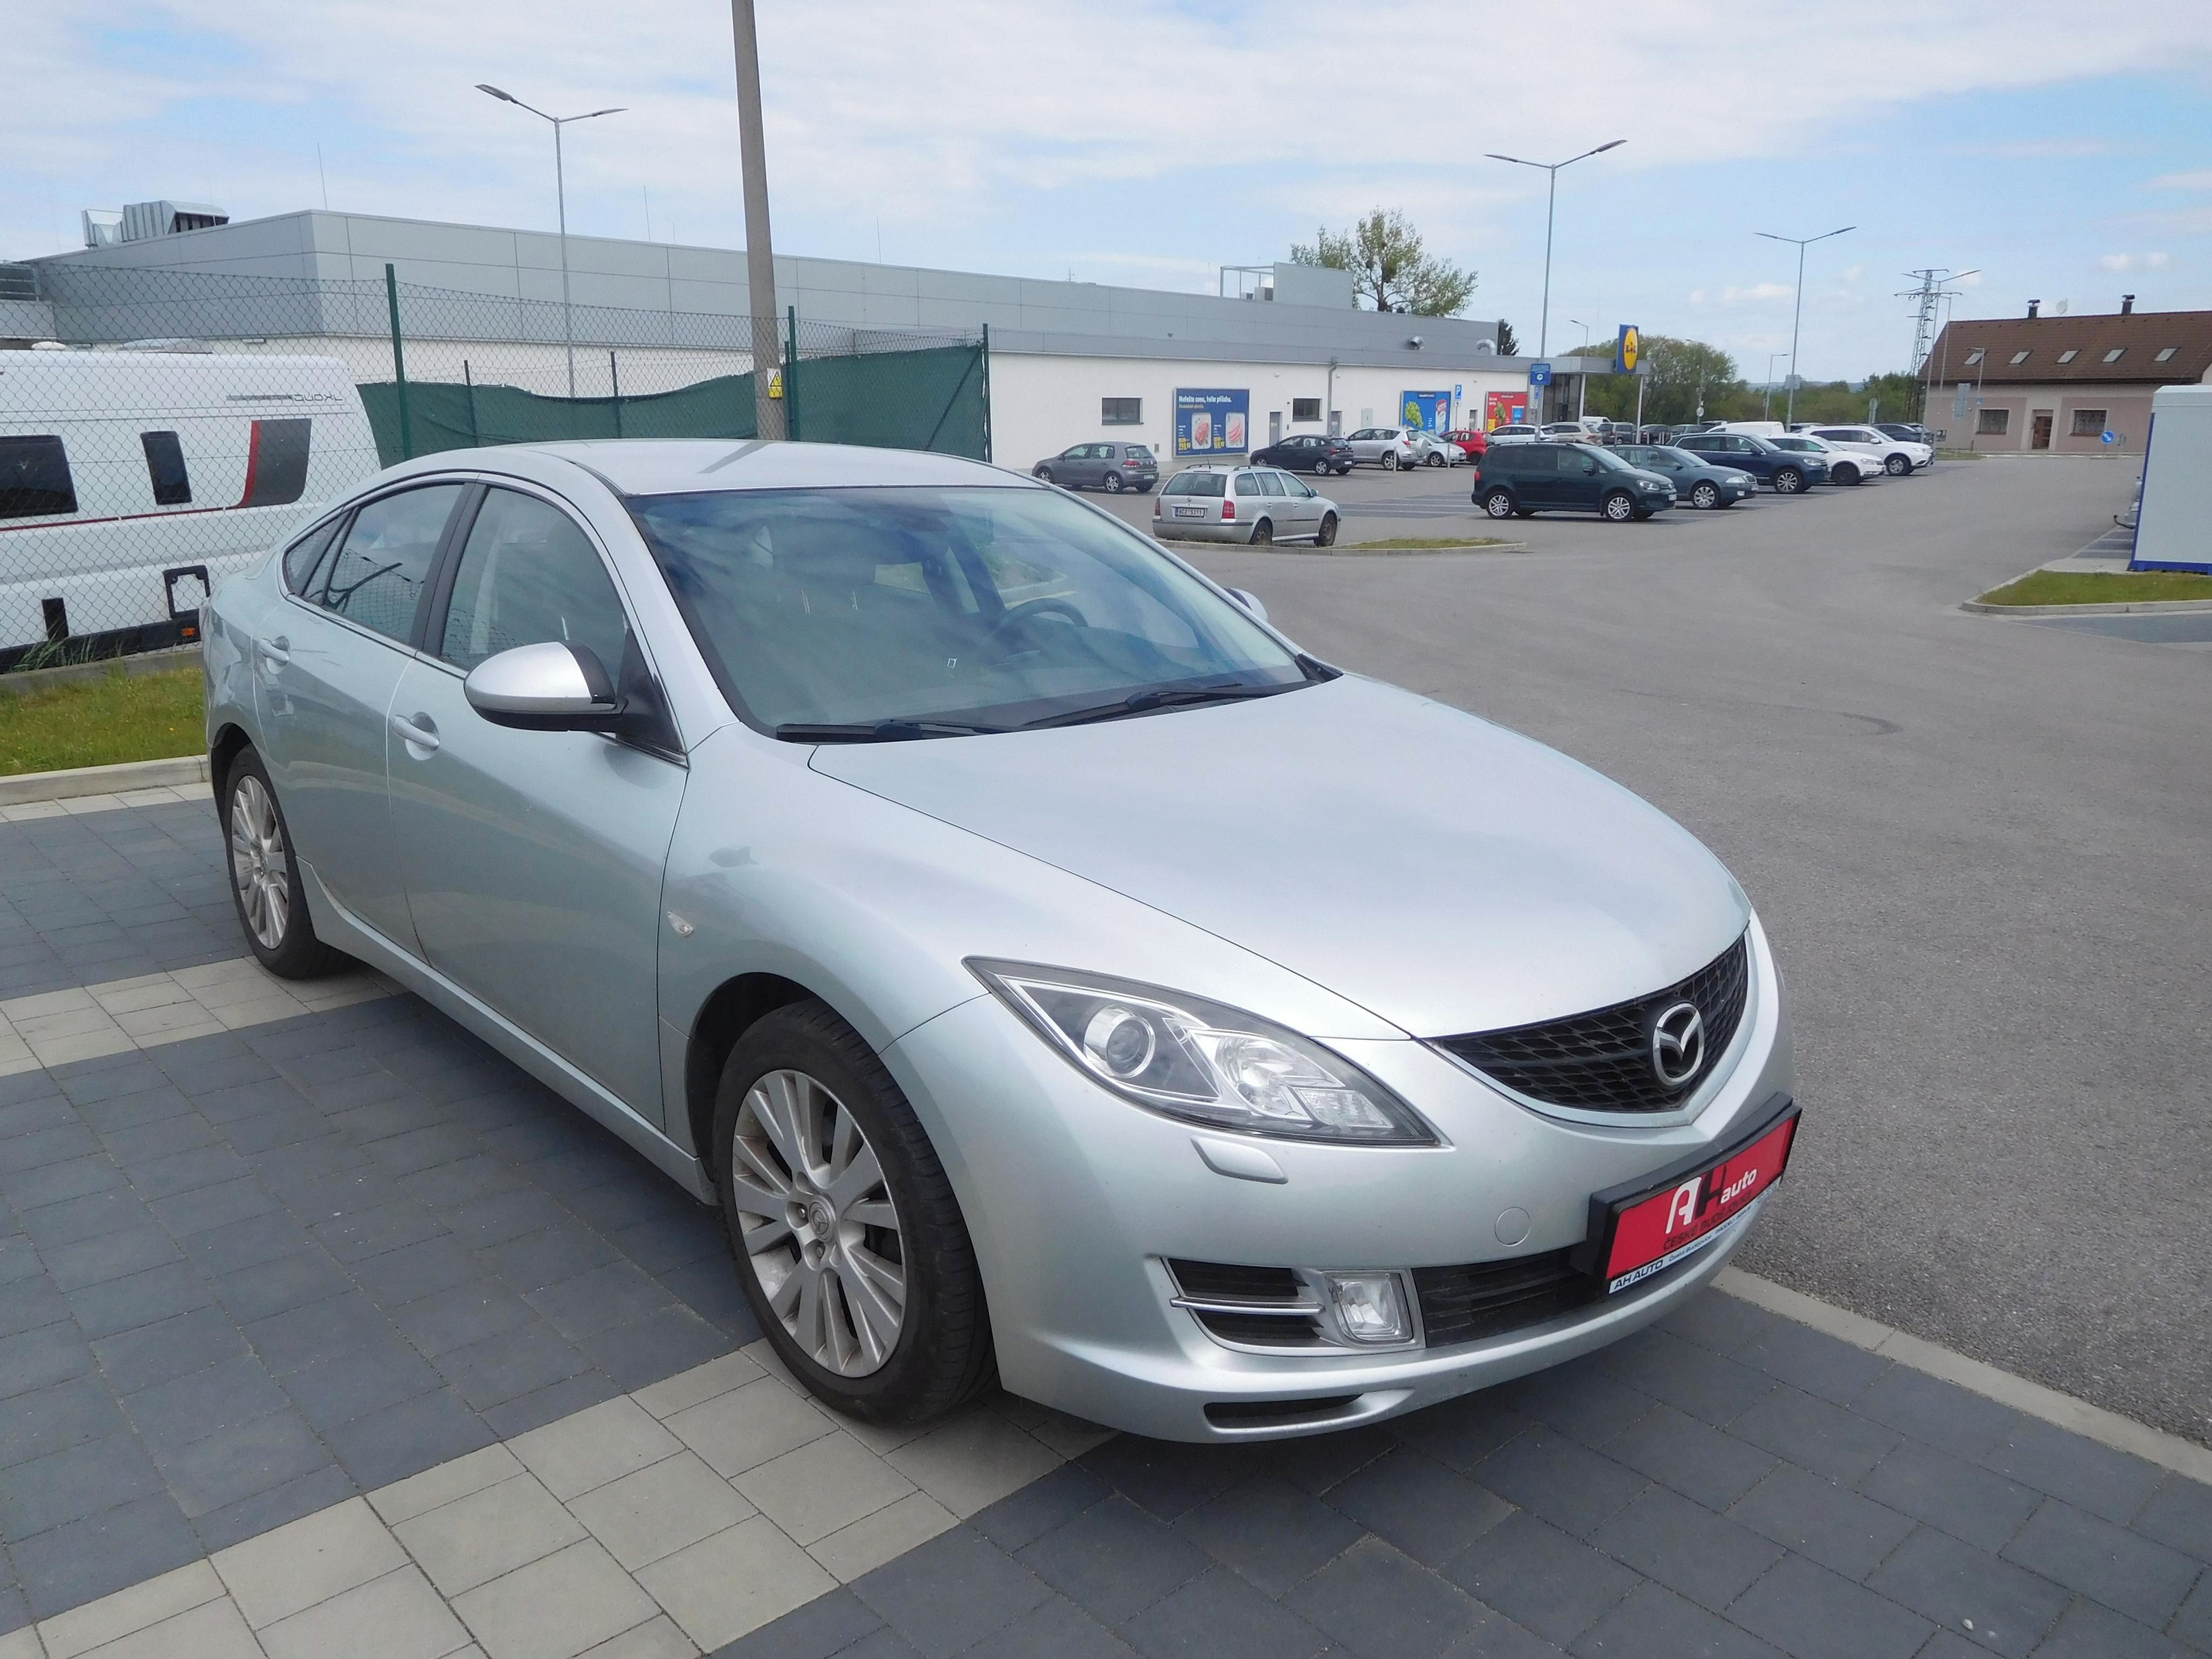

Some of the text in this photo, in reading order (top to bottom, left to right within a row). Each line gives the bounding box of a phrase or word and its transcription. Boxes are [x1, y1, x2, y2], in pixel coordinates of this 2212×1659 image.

[1456, 386, 1461, 395] P
[1663, 1225, 1698, 1251] ČESKÉ
[1614, 1275, 1631, 1290] AH
[1632, 1259, 1663, 1282] AUTO
